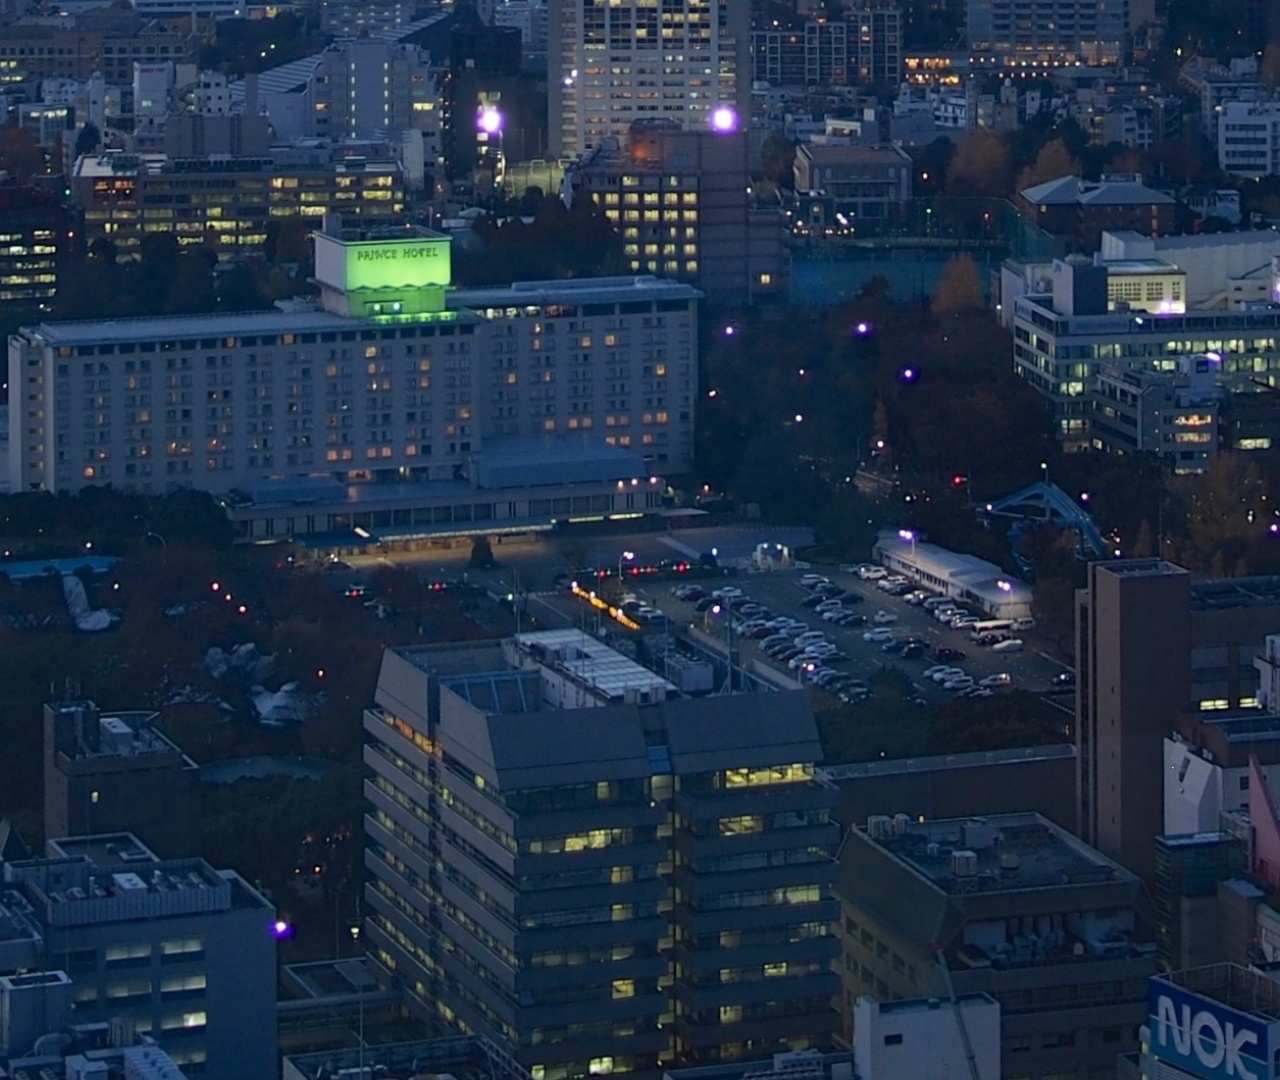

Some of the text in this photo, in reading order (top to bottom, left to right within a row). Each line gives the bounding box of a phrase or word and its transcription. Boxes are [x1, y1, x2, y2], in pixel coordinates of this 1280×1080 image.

[357, 247, 438, 261] PRINCE HOTEL
[1157, 994, 1259, 1080] NOK
